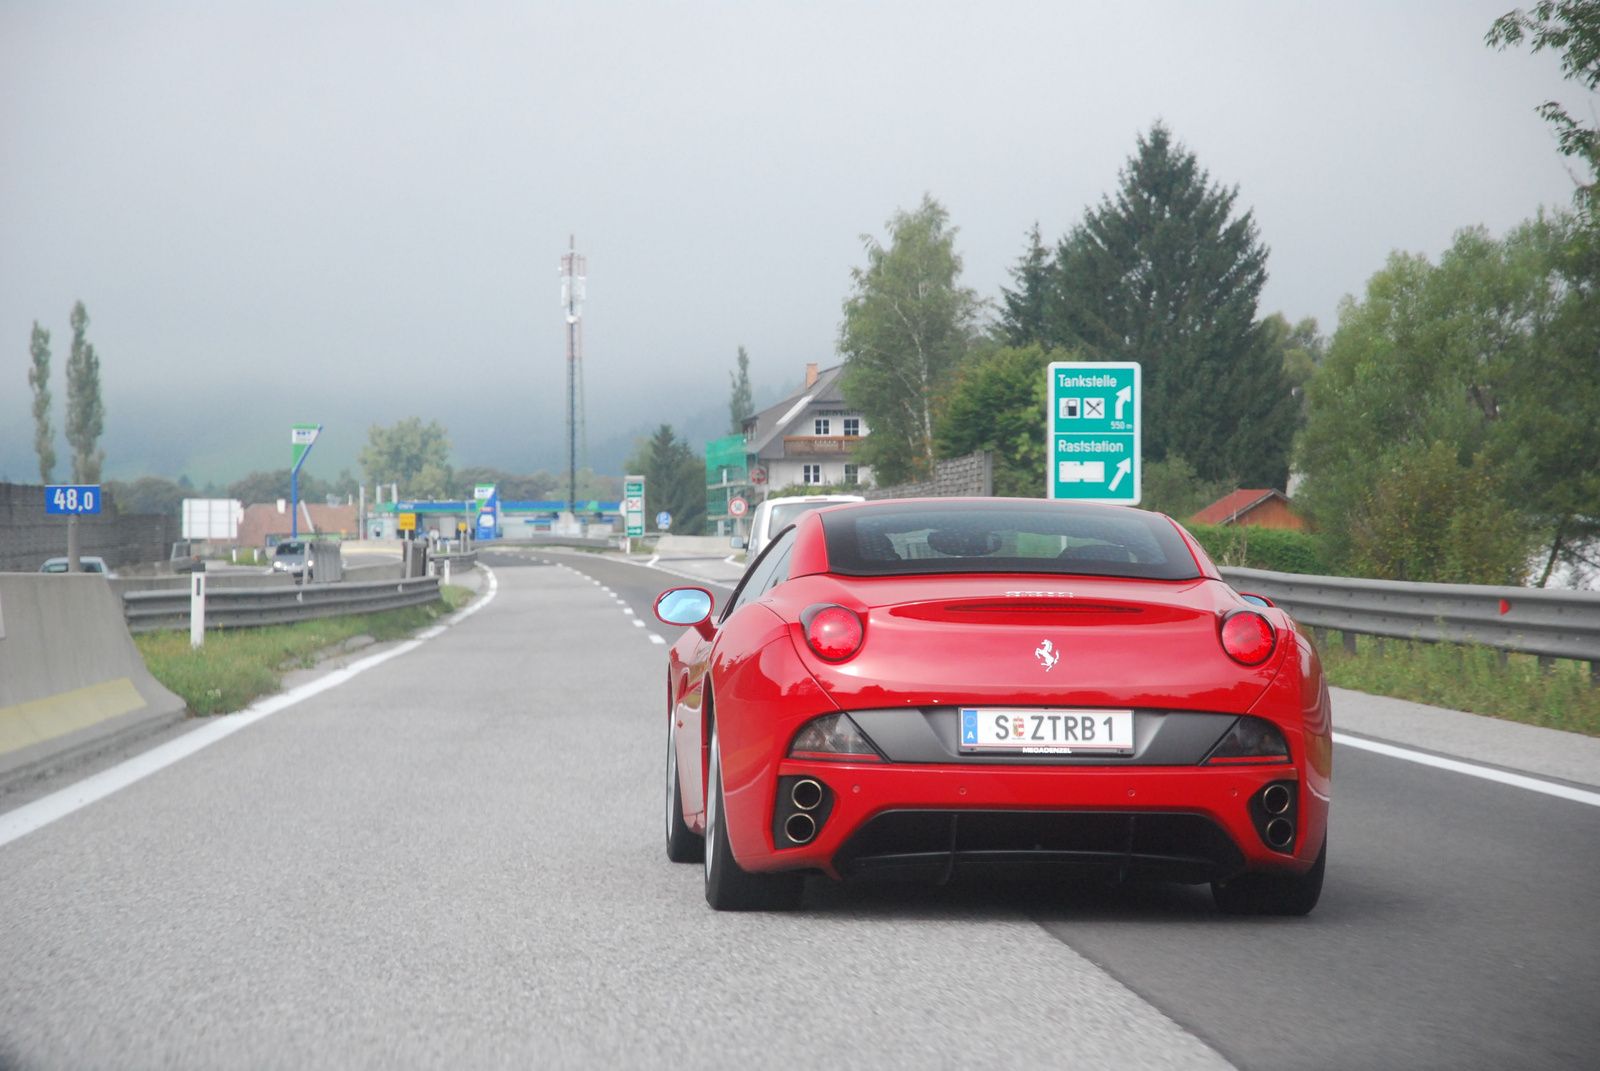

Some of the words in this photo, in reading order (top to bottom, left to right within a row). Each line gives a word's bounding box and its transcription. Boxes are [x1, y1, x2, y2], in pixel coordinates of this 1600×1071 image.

[1058, 374, 1117, 388] Tankstelle
[1110, 421, 1125, 430] 550
[1058, 439, 1124, 453] Raststation
[53, 488, 94, 512] 48,0
[995, 715, 1009, 740] S
[1030, 715, 1095, 741] ZTRB
[1103, 716, 1113, 741] 1
[967, 731, 974, 740] A
[1022, 746, 1072, 754] MEGADENZEL
